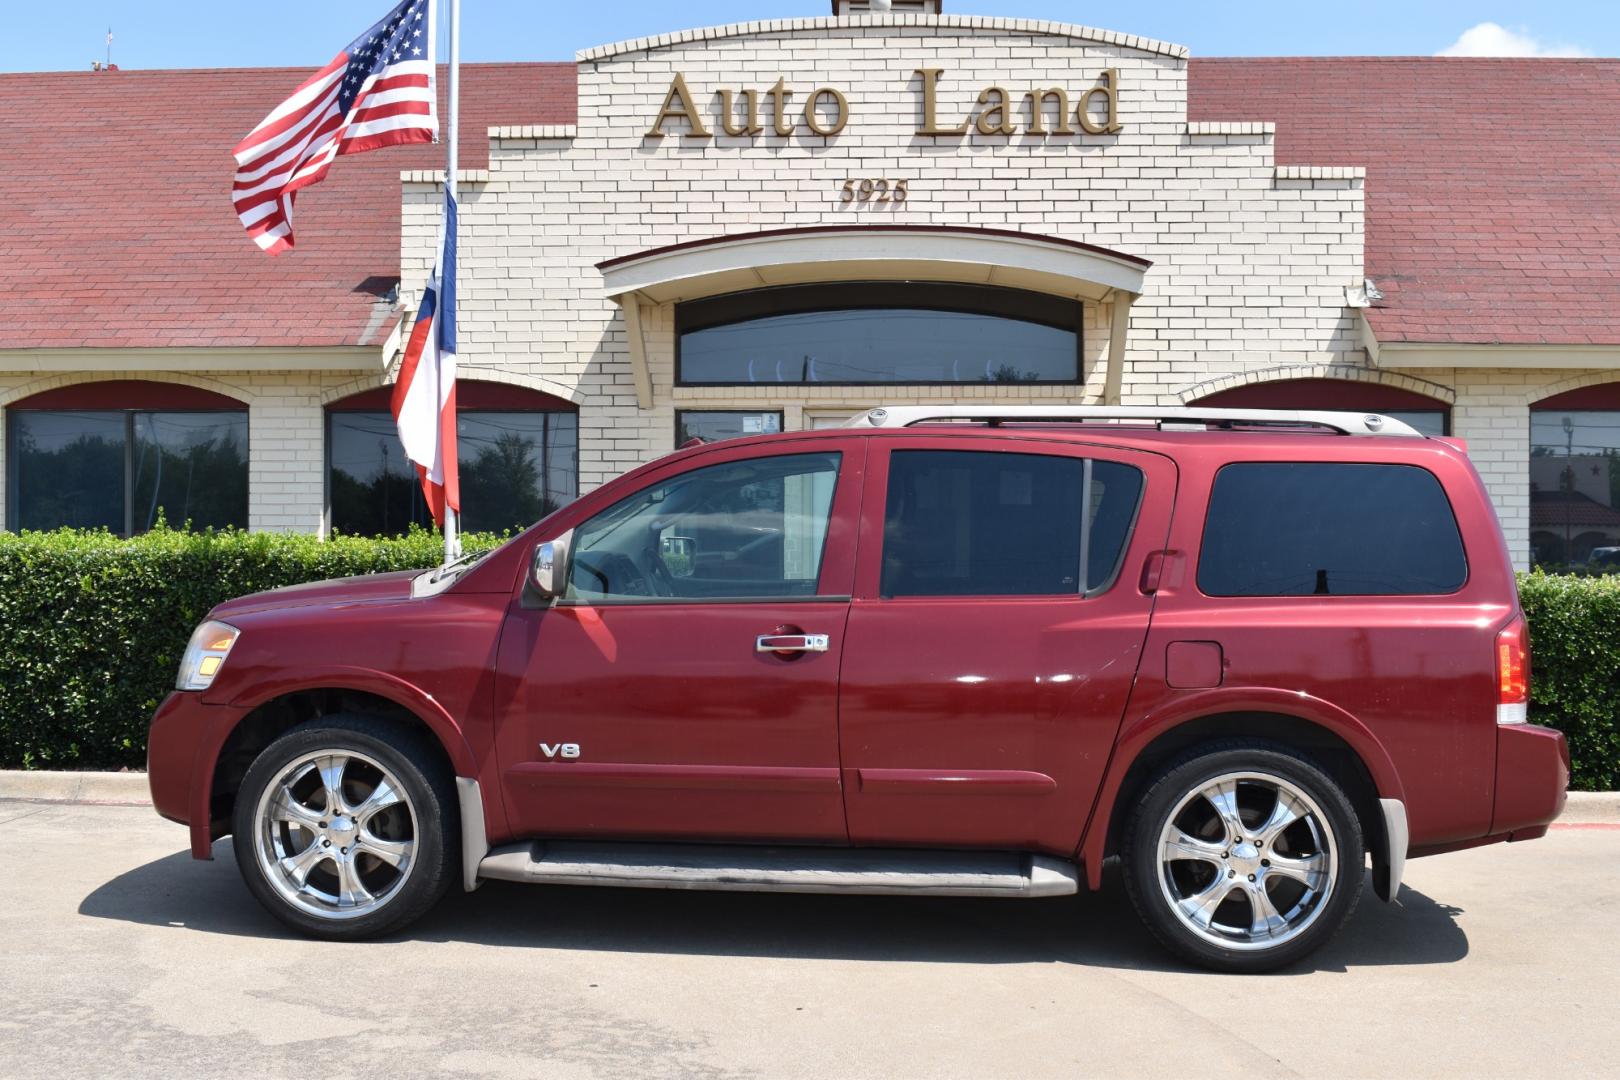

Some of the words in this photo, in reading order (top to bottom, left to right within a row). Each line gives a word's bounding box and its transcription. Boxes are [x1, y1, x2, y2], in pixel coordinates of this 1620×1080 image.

[644, 71, 849, 138] Auto
[914, 67, 1124, 137] Land
[841, 179, 907, 202] 5925
[539, 743, 580, 758] V8
